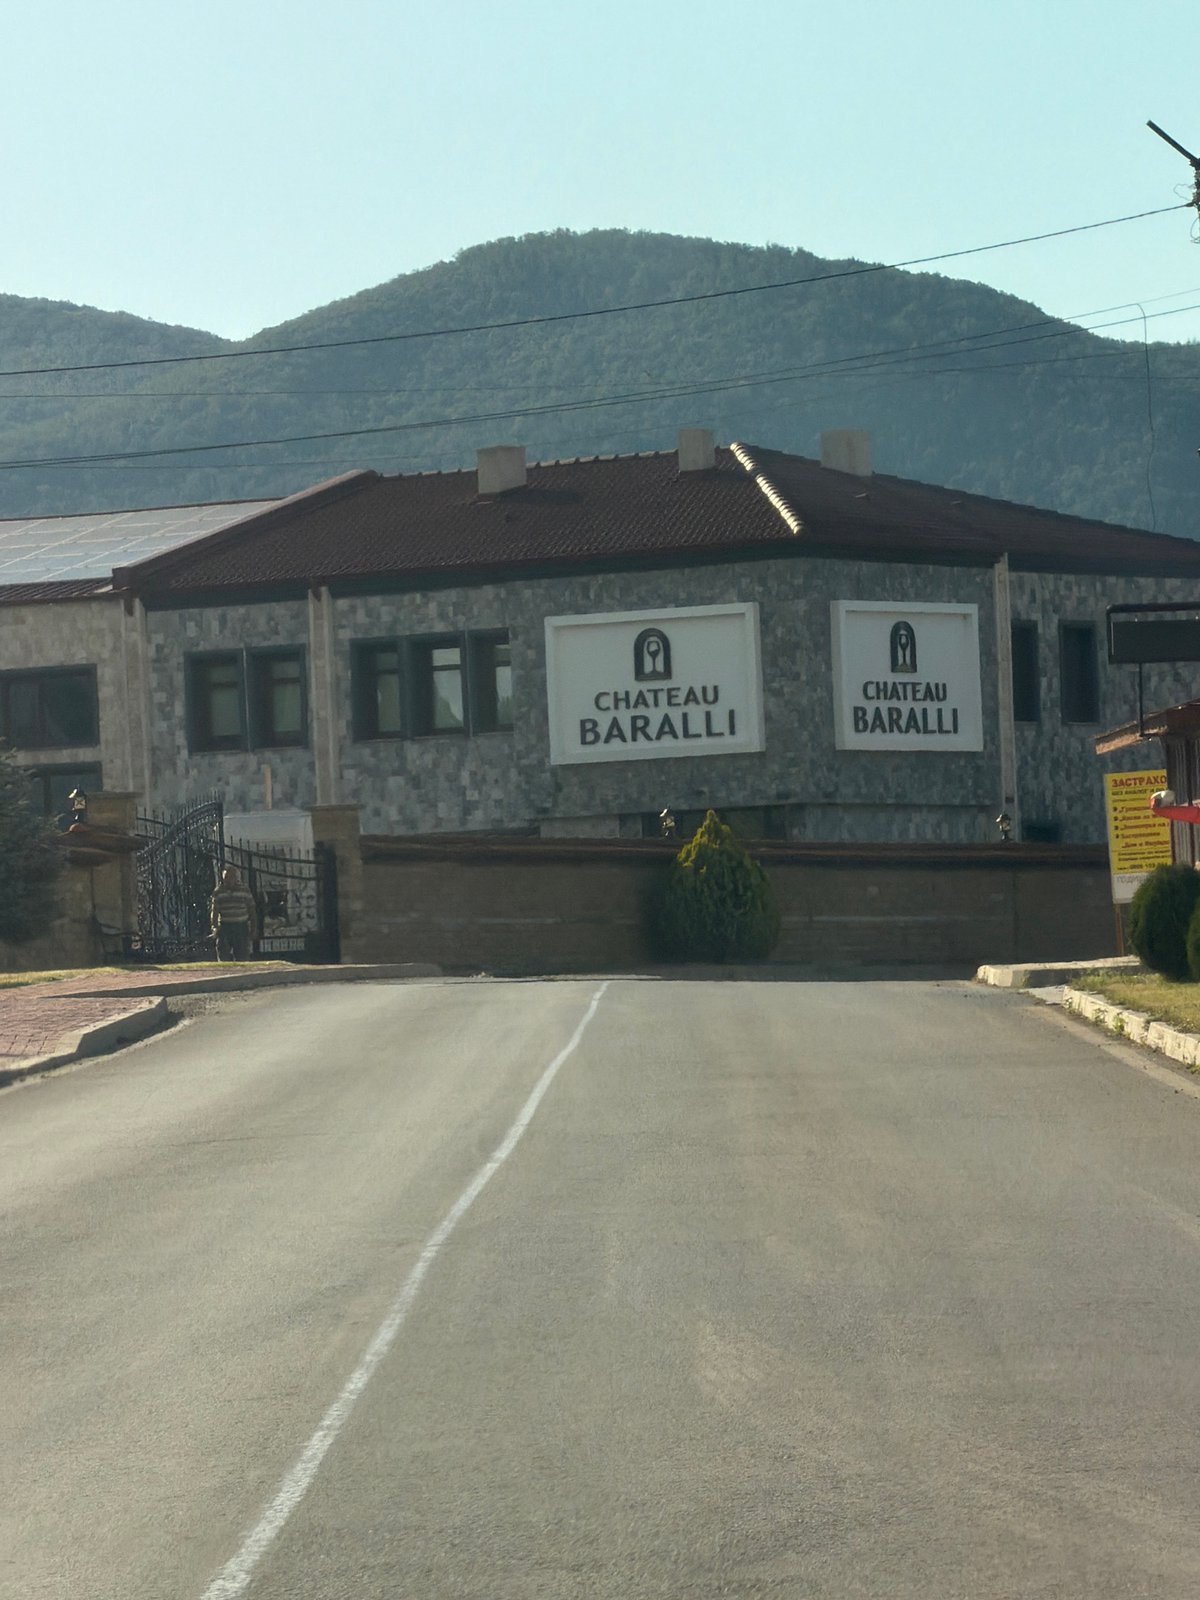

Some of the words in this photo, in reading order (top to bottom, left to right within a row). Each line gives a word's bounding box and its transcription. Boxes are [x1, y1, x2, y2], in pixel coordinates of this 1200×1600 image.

[594, 685, 719, 711] CHATEAU
[863, 681, 947, 702] CHATEAU
[580, 709, 735, 745] BARALLI
[853, 706, 959, 734] BARALLI
